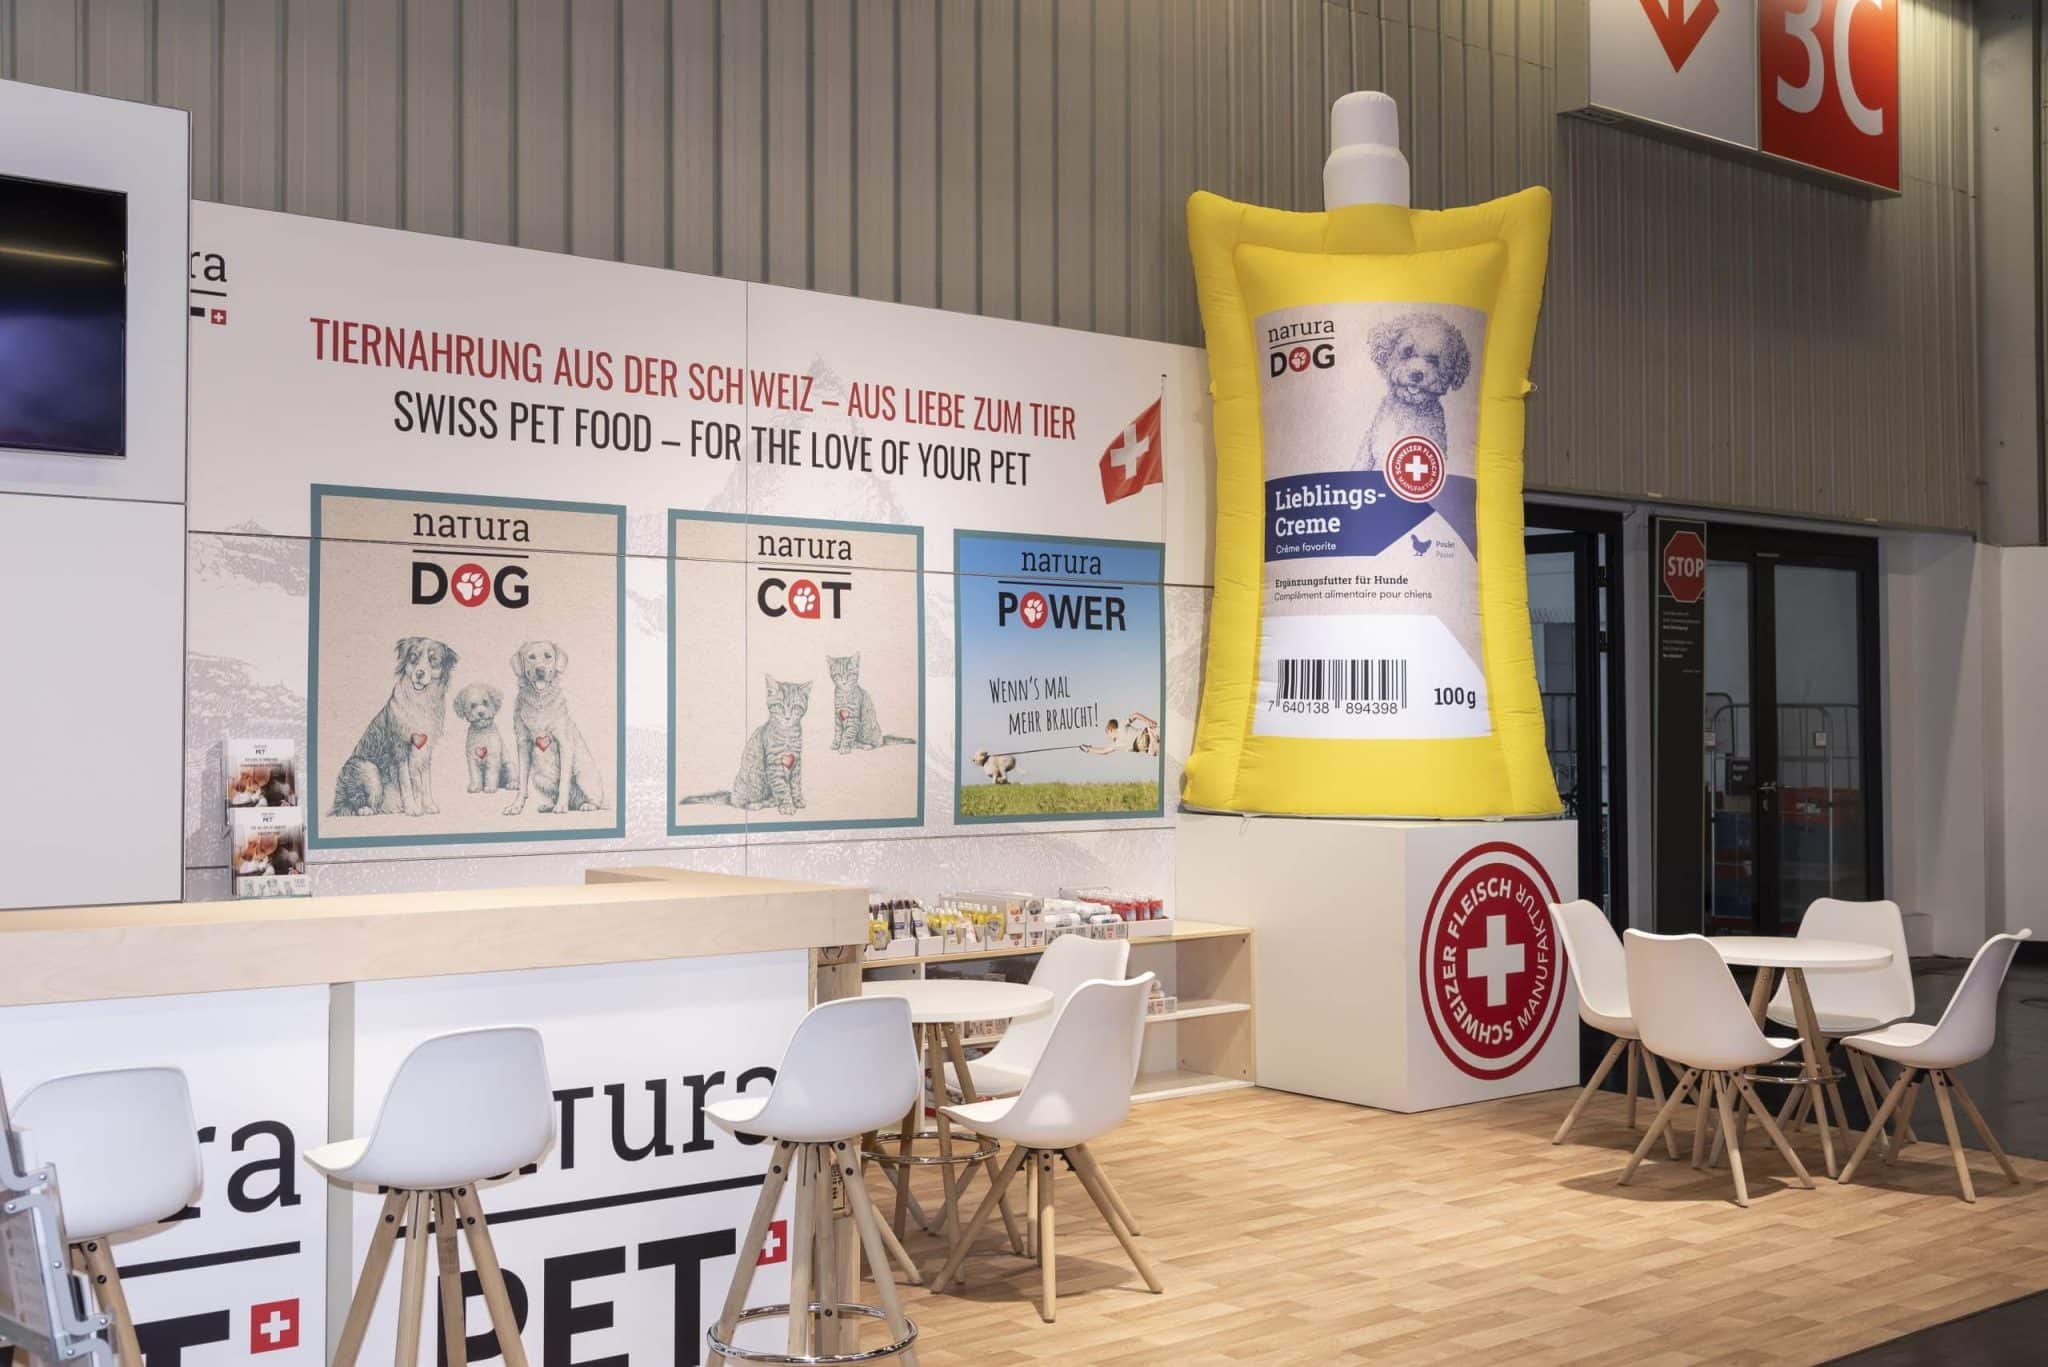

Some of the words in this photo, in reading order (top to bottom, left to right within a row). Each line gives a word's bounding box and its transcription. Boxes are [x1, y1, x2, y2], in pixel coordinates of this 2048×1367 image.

[1777, 0, 1882, 136] 3C
[1270, 344, 1335, 377] DOG
[310, 318, 542, 384] TIERNAHRUNG
[554, 347, 613, 391] AUS
[625, 355, 678, 398] DER
[689, 363, 814, 413] SCHWEIZ
[847, 382, 897, 421] AUS
[905, 387, 965, 429] LIEBE
[974, 396, 1022, 434] ZUM
[1030, 401, 1076, 440] TIER
[395, 390, 498, 440] SWISS
[510, 402, 566, 445] PET
[575, 407, 652, 453] FOOD
[691, 420, 742, 462] FOR
[751, 426, 802, 467] THE
[811, 432, 873, 474] LOVE
[881, 440, 909, 477] OF
[917, 443, 981, 483] YOUR
[990, 451, 1031, 487] PET
[1275, 484, 1386, 511] Lieblings-
[1275, 516, 1341, 537] Creme
[1302, 541, 1337, 553] favorite
[1275, 576, 1352, 589] Ergänzungsfutter
[1355, 575, 1371, 585] für
[1374, 575, 1409, 585] Hunde
[1667, 556, 1704, 577] STOP
[412, 562, 530, 609] DOG
[1324, 589, 1377, 599] alimentaire
[1380, 591, 1401, 601] pour
[1404, 589, 1433, 599] chiens
[999, 590, 1127, 631] POWER
[1045, 677, 1071, 700] MAL
[1008, 709, 1042, 735] MEHR
[1046, 704, 1099, 731] BRAUCHT!
[1268, 701, 1274, 712] 7
[1282, 703, 1330, 715] 640138
[1346, 703, 1398, 715] 894398
[1447, 877, 1512, 938] FLEISCH
[1515, 884, 1550, 1030] MANUFAKTUR
[1443, 946, 1514, 1045] SCHWEIZER
[437, 1228, 736, 1367] PET
